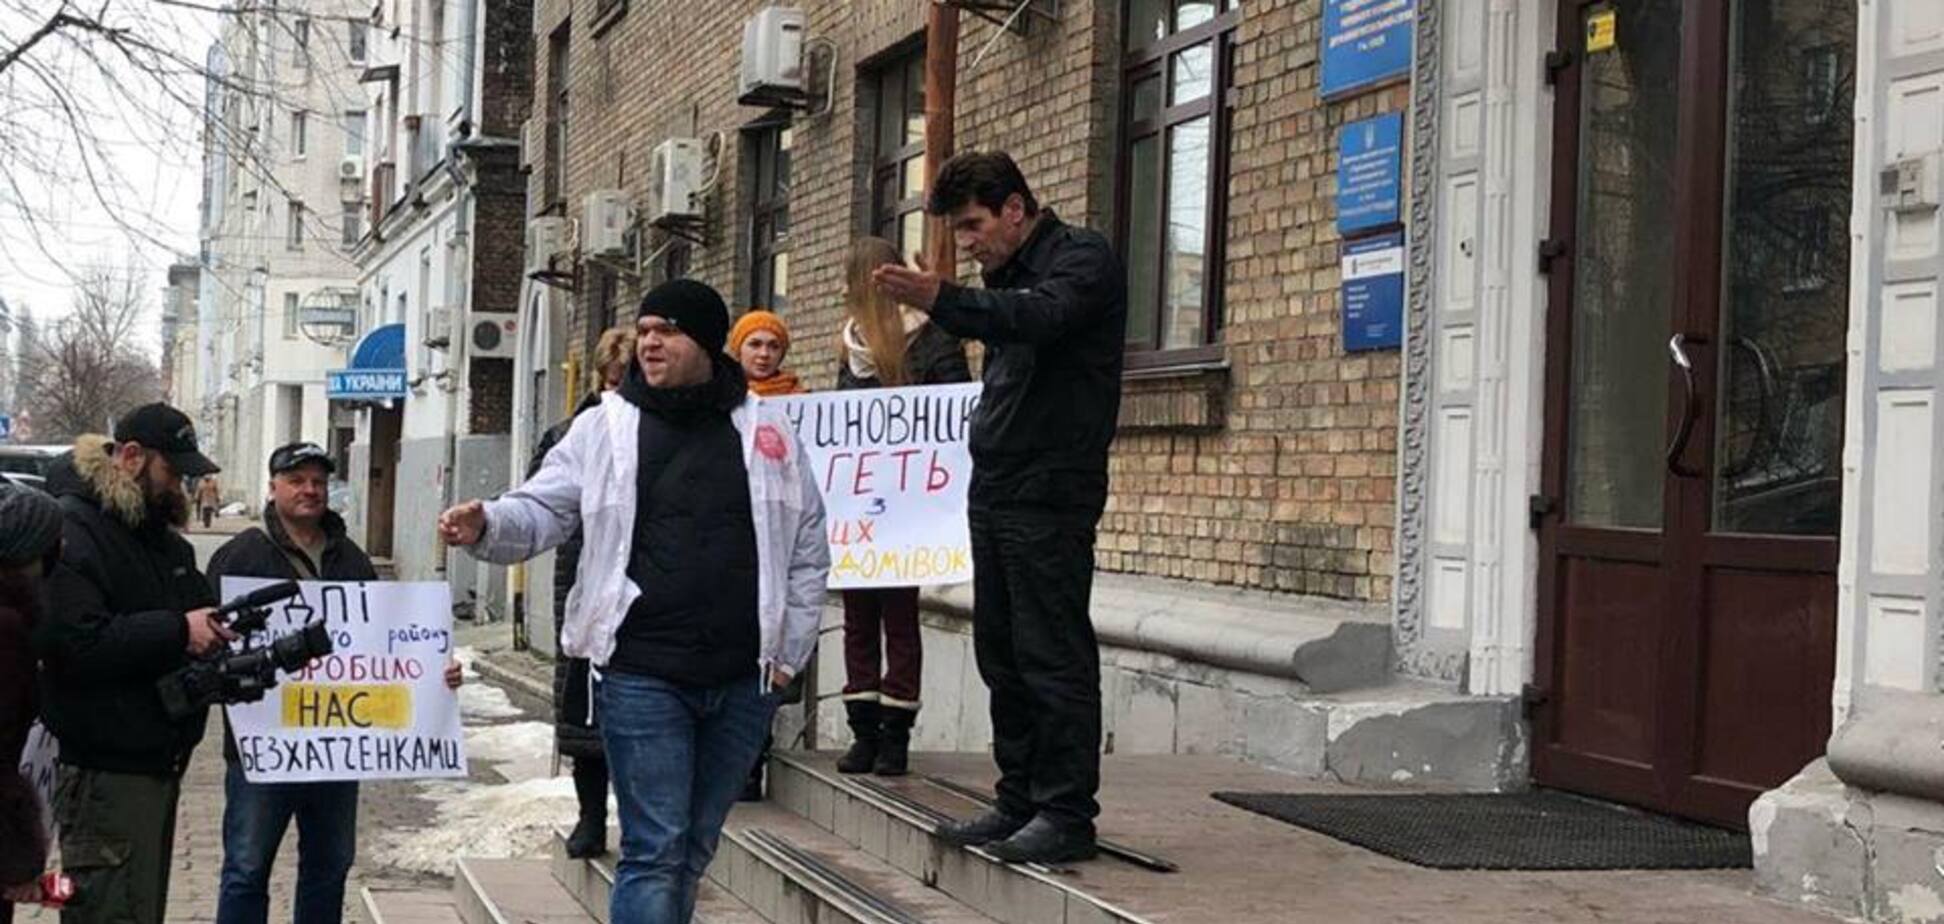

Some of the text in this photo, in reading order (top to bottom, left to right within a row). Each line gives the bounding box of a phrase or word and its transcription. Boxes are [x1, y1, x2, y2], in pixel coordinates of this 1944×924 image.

[826, 449, 950, 495] ГЕТЬ
[832, 547, 968, 580] ДОМІВОК
[298, 687, 373, 728] НАС
[239, 735, 462, 773] БЕЗХАТЧЕНКАМИ
